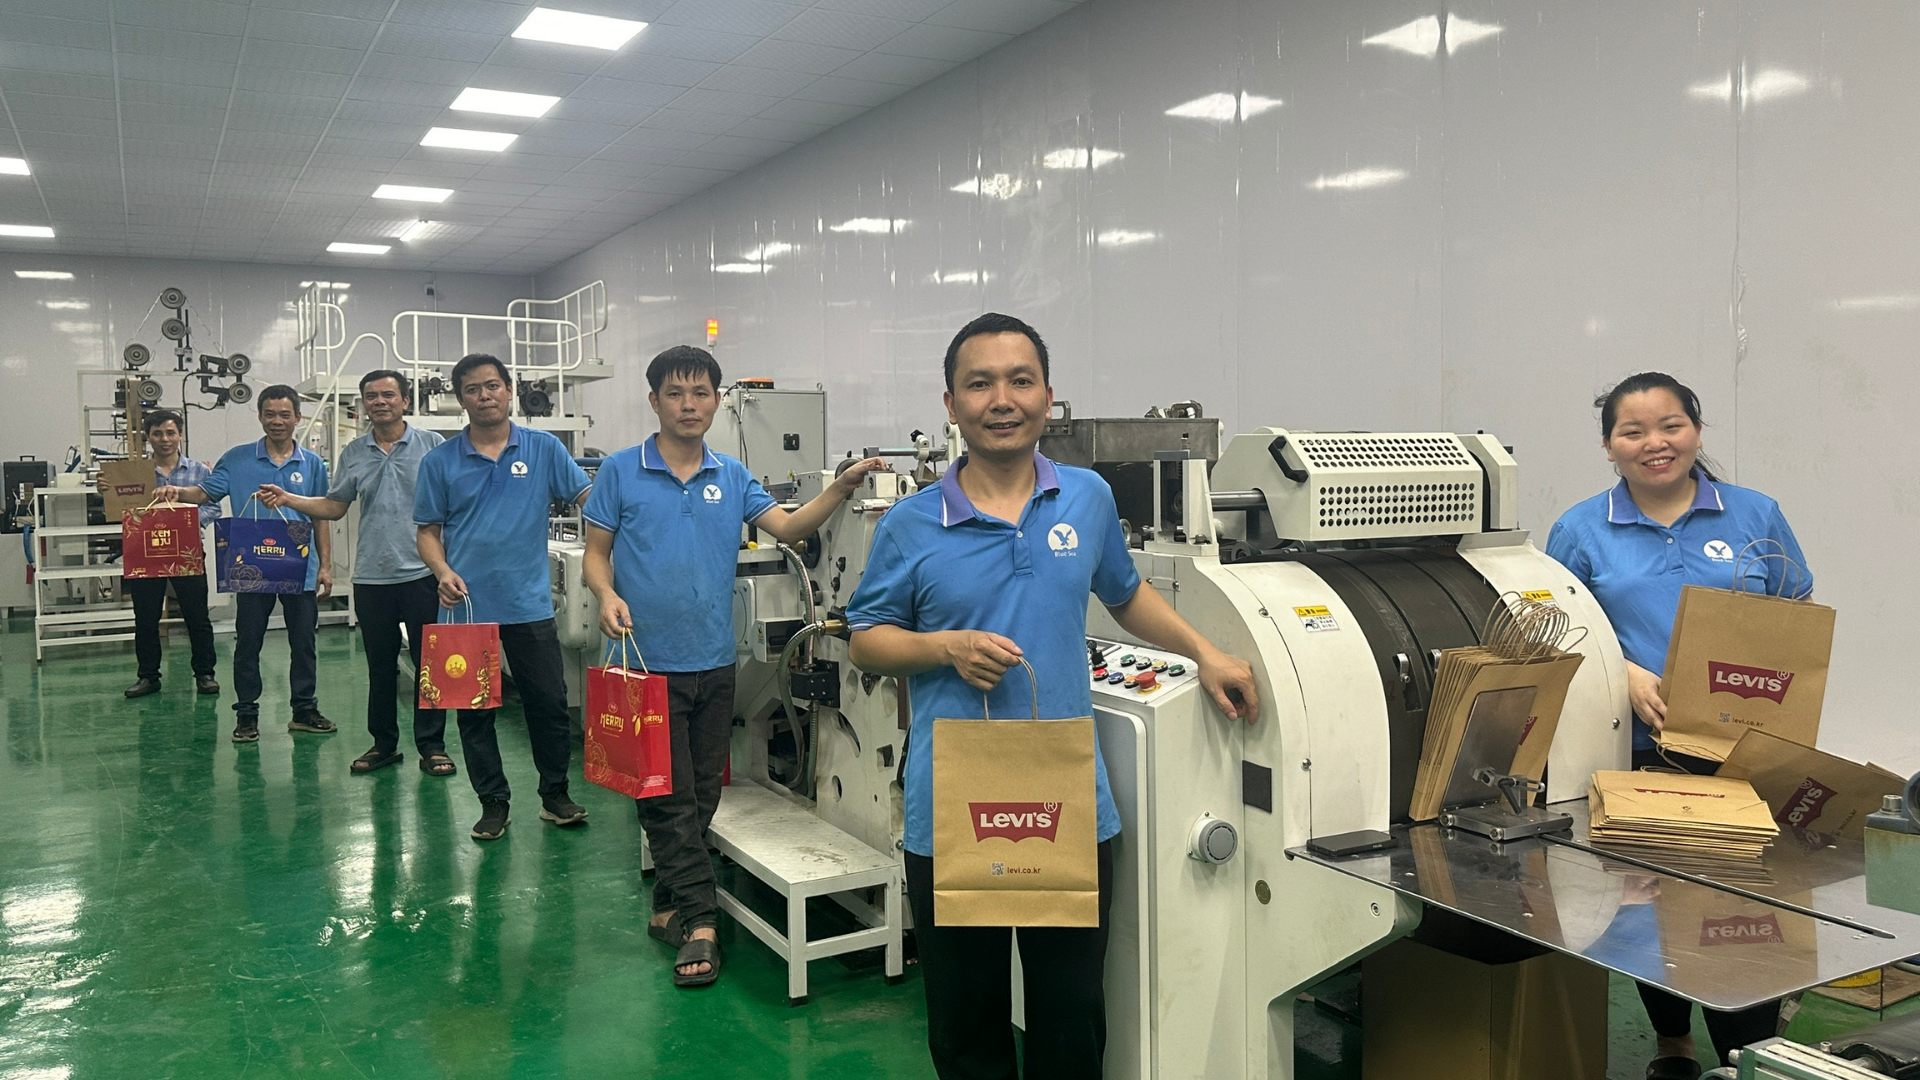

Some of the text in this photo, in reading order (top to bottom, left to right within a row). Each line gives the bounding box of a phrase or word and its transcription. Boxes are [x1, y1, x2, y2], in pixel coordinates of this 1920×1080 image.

[253, 545, 285, 556] MERRY
[1715, 670, 1782, 692] LeVI'S
[600, 712, 624, 732] MERRY
[1788, 787, 1823, 826] eVI'S
[980, 812, 1052, 828] LeVI'S
